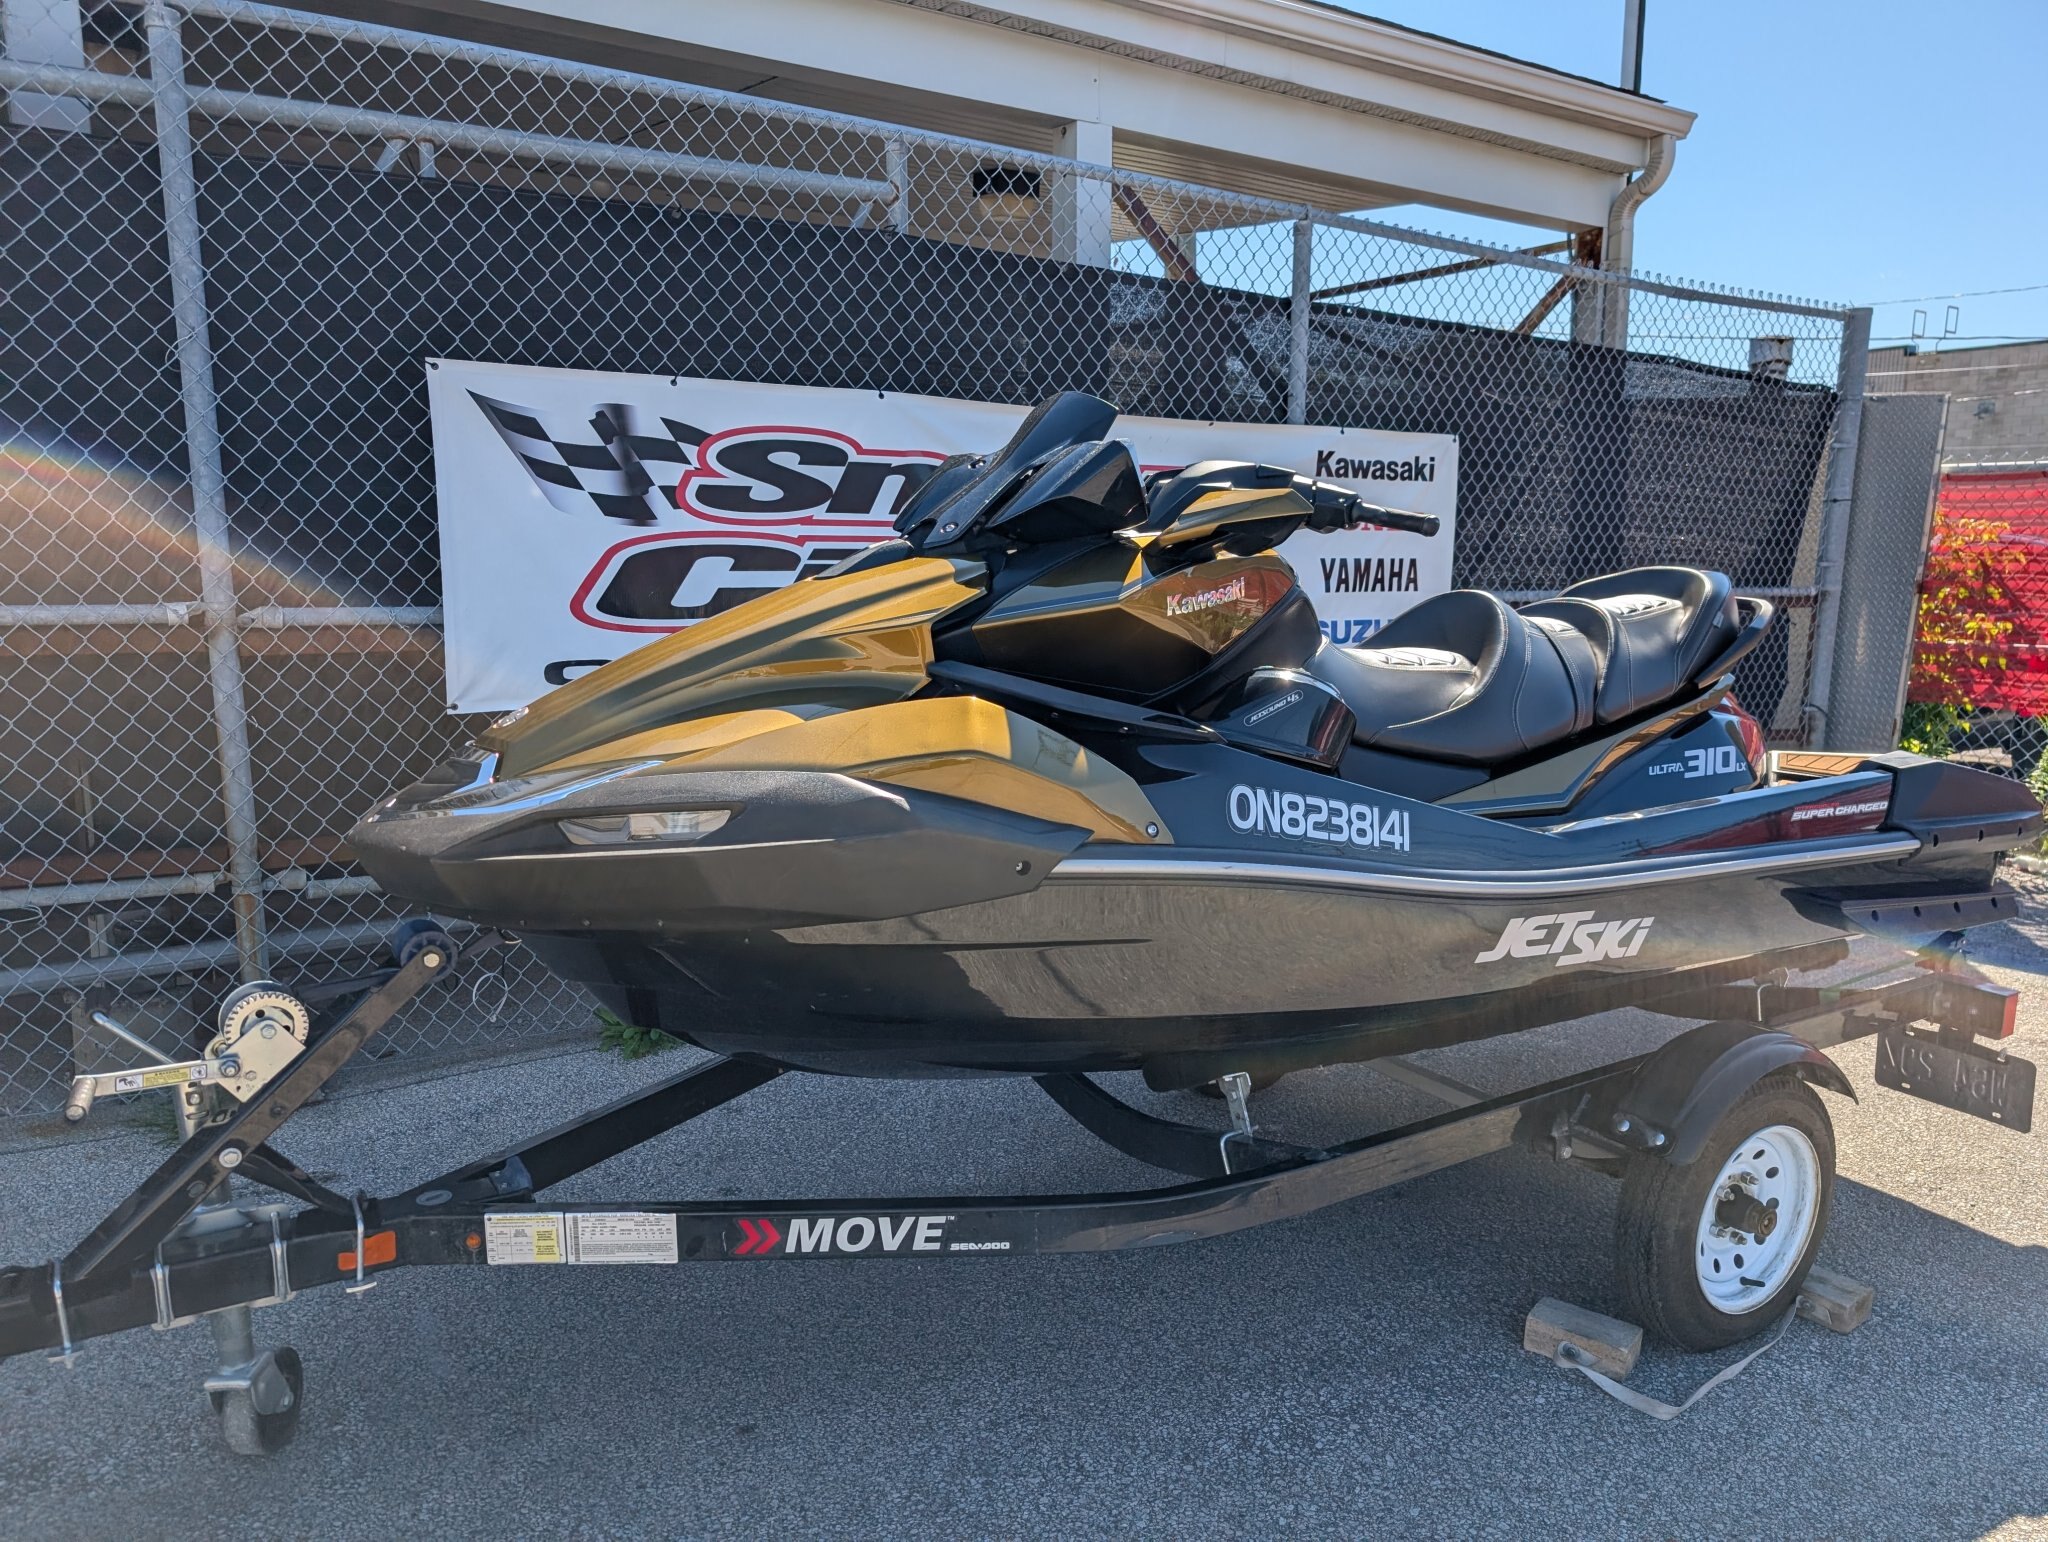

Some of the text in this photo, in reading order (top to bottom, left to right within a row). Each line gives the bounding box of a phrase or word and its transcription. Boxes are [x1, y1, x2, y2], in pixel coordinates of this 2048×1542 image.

[1315, 450, 1436, 482] Kawasaki
[1320, 557, 1419, 593] YAMAHA
[1166, 576, 1245, 617] Kawasaki
[1249, 700, 1287, 724] JETSOUND
[1648, 745, 1747, 779] ULTRA 310 LX
[1791, 807, 1835, 821] SUPER
[1835, 801, 1889, 816] CHARGED
[785, 1215, 947, 1253] MOVE
